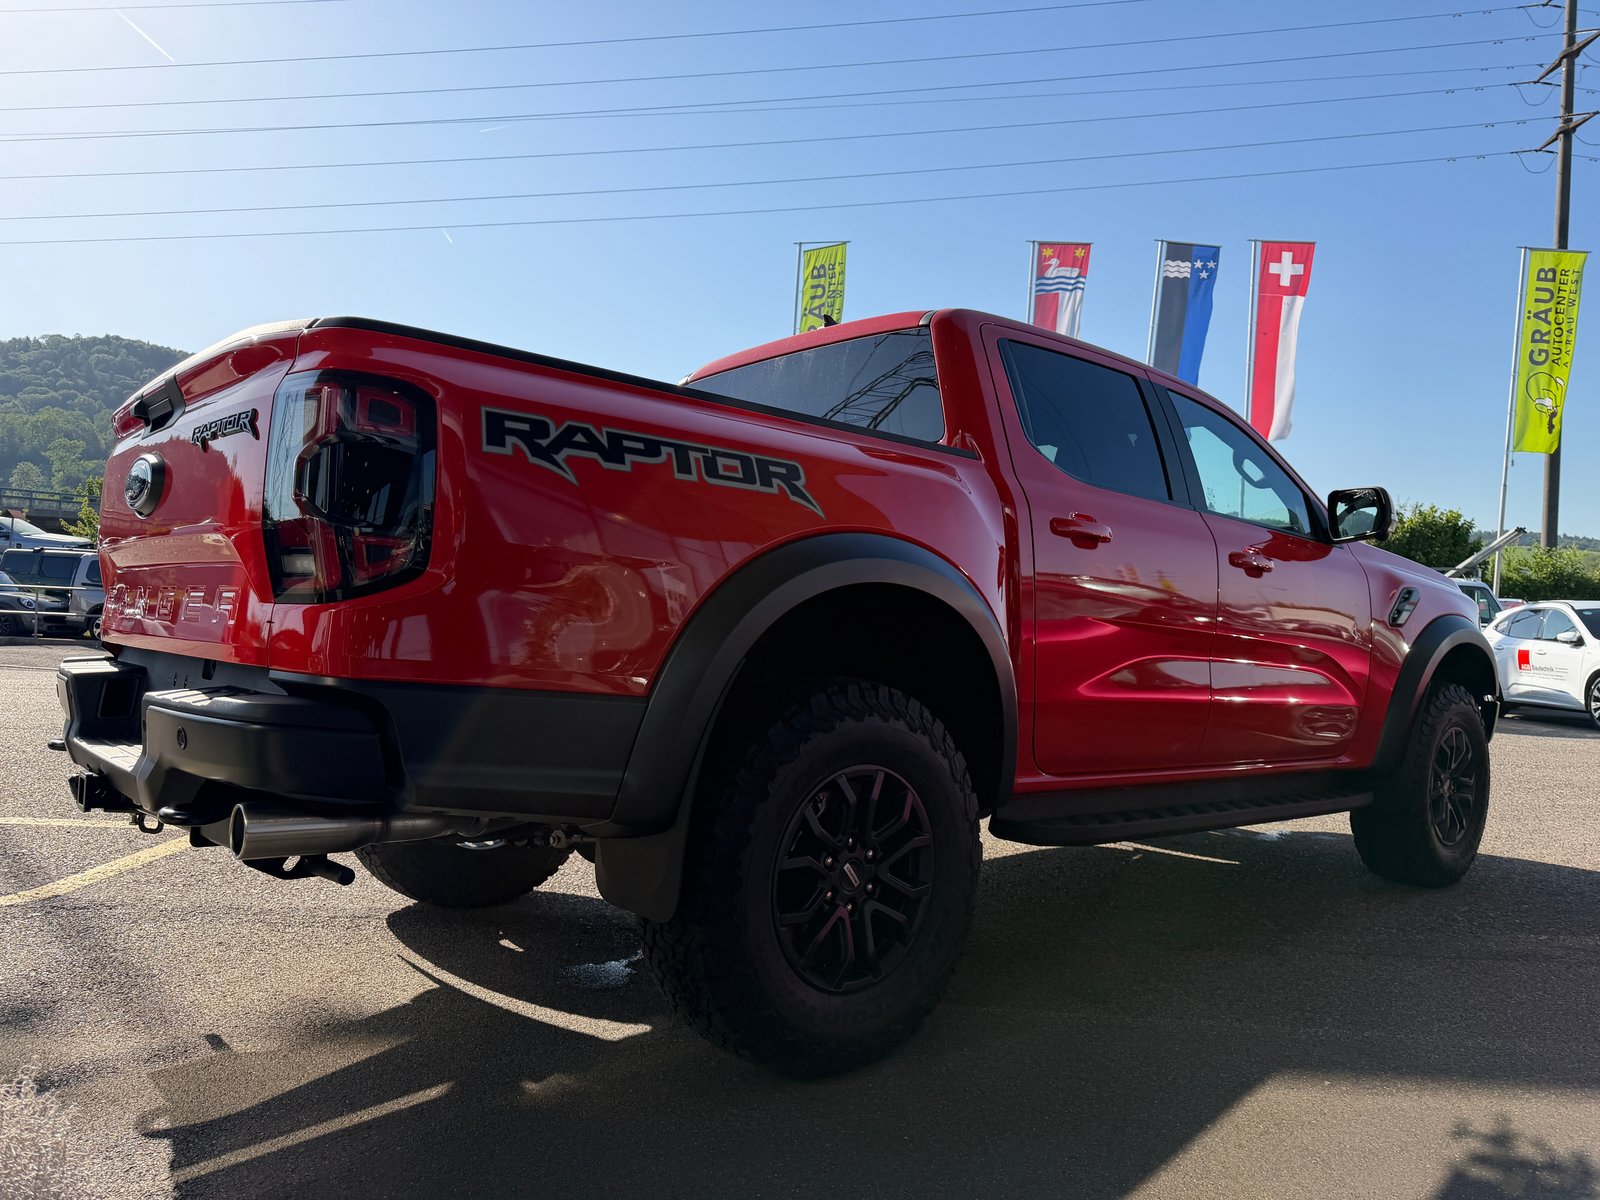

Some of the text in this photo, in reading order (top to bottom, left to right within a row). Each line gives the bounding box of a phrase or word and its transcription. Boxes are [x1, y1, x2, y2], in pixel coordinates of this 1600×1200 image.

[803, 264, 827, 331] ÄUB
[1527, 267, 1557, 367] GRÄUB
[1551, 268, 1571, 367] AUTOCENTER
[1563, 269, 1581, 368] AARAU WEST
[190, 407, 260, 453] RAPTOR
[480, 405, 827, 520] RAPTOR
[106, 583, 241, 625] RANGER
